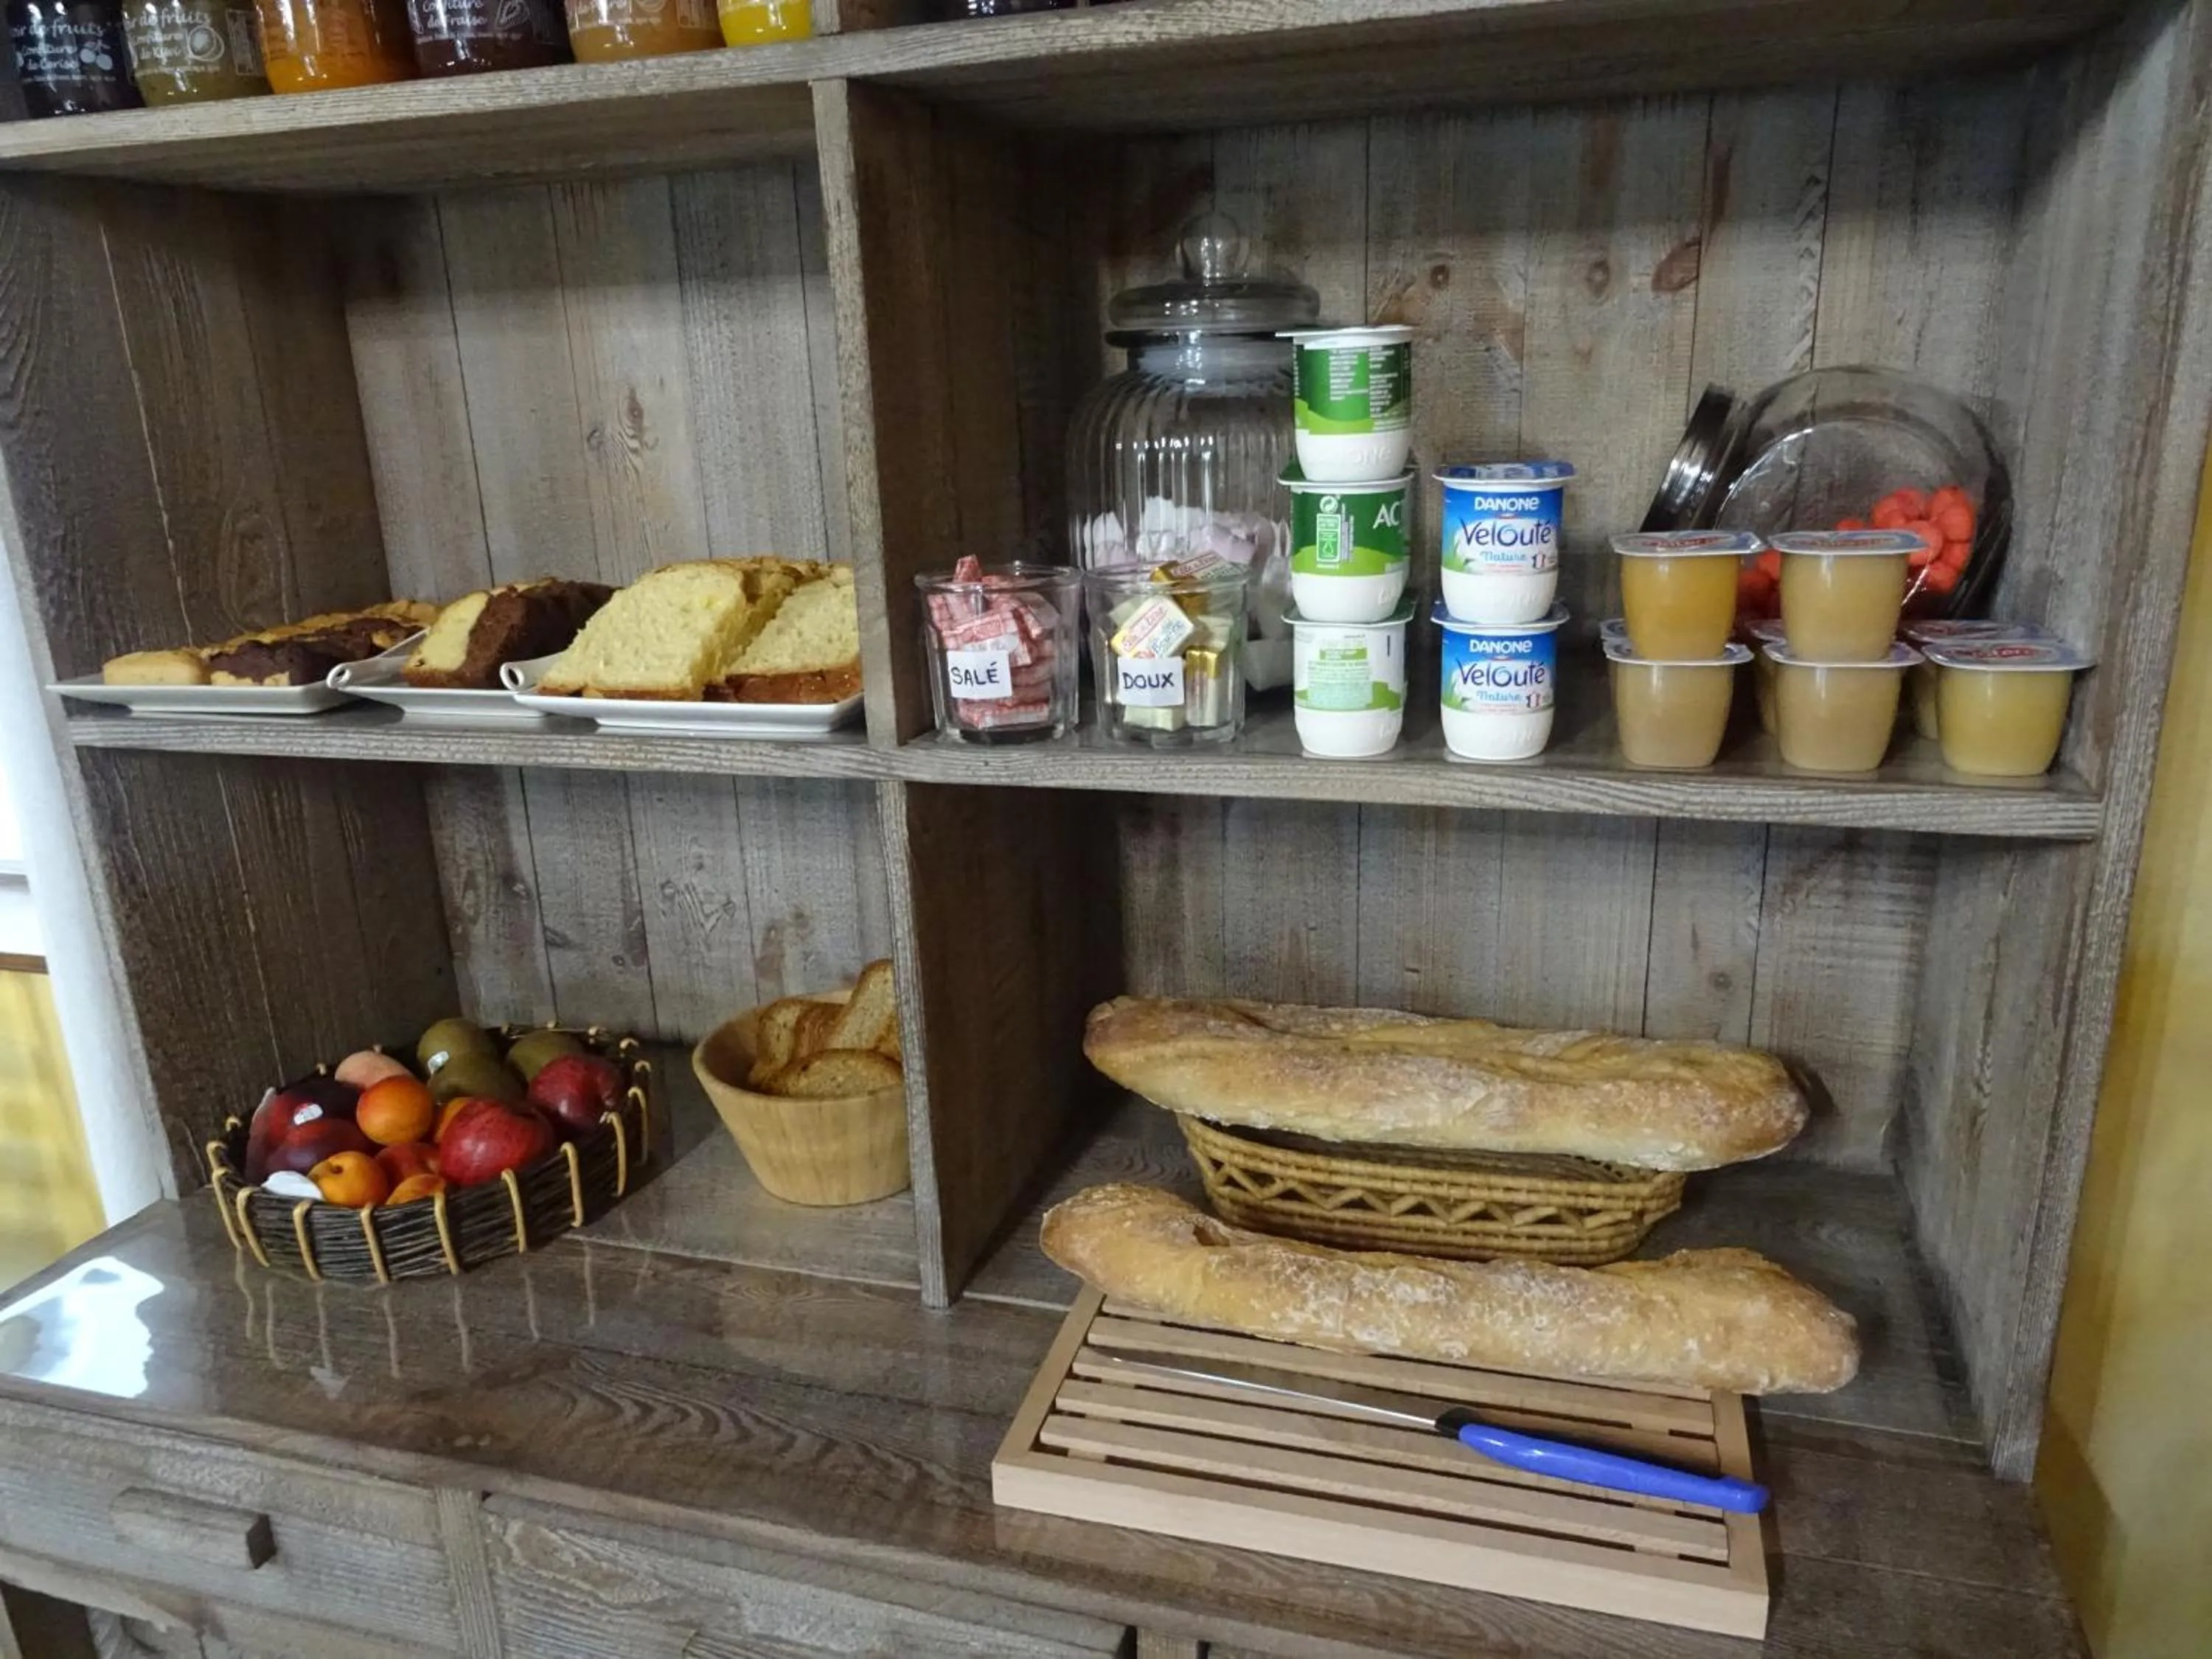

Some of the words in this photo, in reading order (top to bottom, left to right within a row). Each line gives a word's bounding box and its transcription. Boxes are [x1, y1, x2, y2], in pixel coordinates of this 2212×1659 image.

[1459, 516, 1551, 546] Velouté
[950, 661, 1000, 686] SALÉ
[1123, 672, 1175, 689] DOUX
[1455, 658, 1545, 687] Velouté
